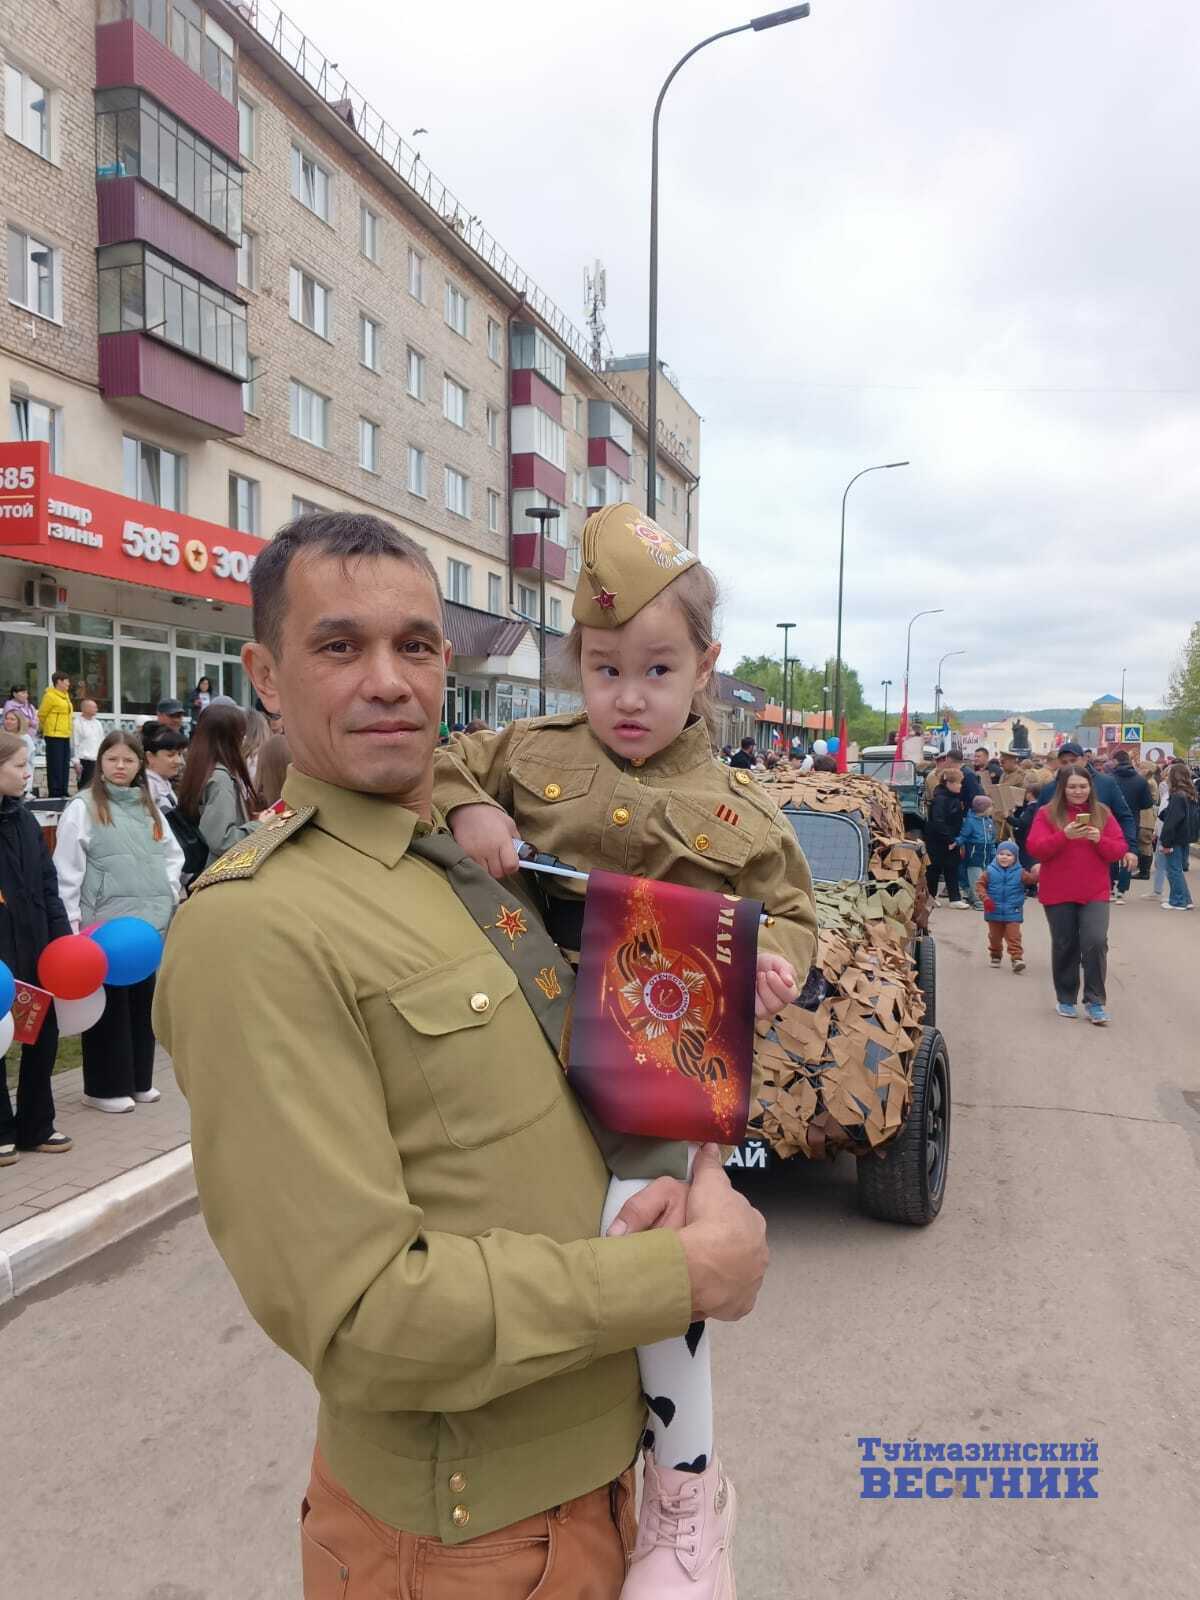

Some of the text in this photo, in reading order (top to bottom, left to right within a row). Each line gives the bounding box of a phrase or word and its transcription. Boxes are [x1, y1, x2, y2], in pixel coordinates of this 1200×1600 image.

[0, 466, 34, 489] 85
[0, 502, 34, 519] ТОЙ
[48, 522, 103, 549] зины
[121, 520, 180, 566] 585
